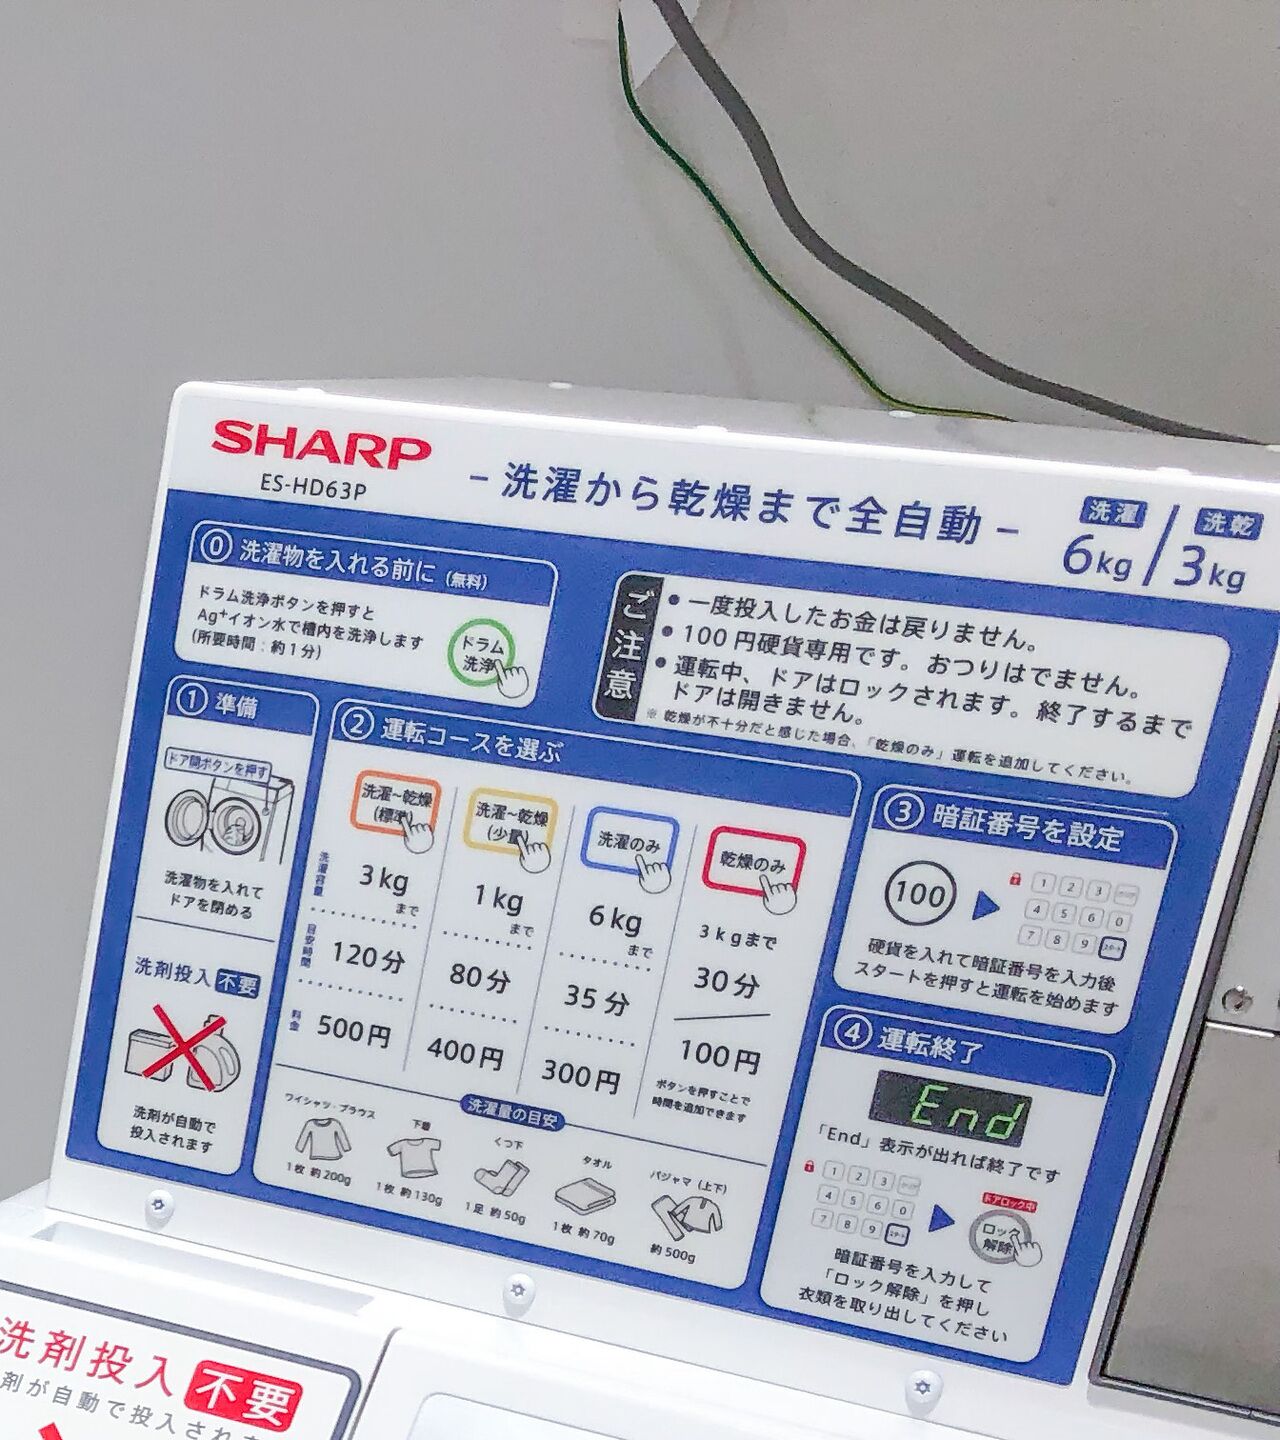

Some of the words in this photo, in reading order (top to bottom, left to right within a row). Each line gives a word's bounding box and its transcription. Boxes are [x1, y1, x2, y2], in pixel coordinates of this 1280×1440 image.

[210, 419, 433, 470] SHARP
[260, 473, 367, 501] ES-HD63P
[239, 538, 436, 584] 洗濯物を入れる前に
[1062, 533, 1133, 582] 6kg
[1173, 544, 1246, 593] 3kg
[198, 585, 375, 622] ドラム洗浄ボタンを押すと
[687, 594, 1039, 653] 一度投入したお金は戻りません。
[461, 635, 505, 656] ドラム
[604, 591, 656, 699] ご注意
[215, 692, 259, 719] 準備
[674, 682, 866, 727] ドアは開きません。
[381, 716, 565, 764] 運転コースを選ぶ
[597, 830, 661, 855] 洗濯のみ
[932, 803, 1125, 853] 暗証番号を設定
[720, 850, 787, 876] 乾燥のみ
[164, 870, 264, 900] 洗濯物を入れて
[359, 864, 409, 896] 3kg
[895, 878, 946, 908] 100
[169, 894, 252, 919] ドアを閉める
[396, 902, 419, 918] まで
[474, 883, 524, 915] 1kg
[509, 921, 535, 938] まで
[589, 904, 643, 936] 6kg
[332, 939, 406, 975] 120分
[627, 944, 654, 960] まで
[867, 937, 1116, 992] 硬貨を入れて暗証番号を入力後
[134, 956, 211, 988] 洗剤投入
[218, 972, 259, 997] 不要
[450, 962, 512, 995] 80分
[694, 967, 760, 999] 30分
[855, 960, 1119, 1017] スタートを押すと運転を始めます
[564, 984, 630, 1018] 35分
[289, 1009, 302, 1032] 料金
[317, 1014, 391, 1050] 500円
[427, 1037, 504, 1073] 400円
[679, 1039, 761, 1076] 100円
[877, 1027, 984, 1066] 運転終了
[541, 1059, 621, 1097] 300円
[656, 1078, 751, 1107] ボタンを押すことで
[133, 1105, 216, 1135] 洗剤が自動で
[412, 1118, 432, 1132] 下着
[467, 1096, 558, 1129] 洗濯量の目安
[651, 1096, 747, 1124] 時間を追加できます
[909, 1083, 1028, 1141] End
[129, 1126, 213, 1154] 投入されます
[494, 1136, 524, 1151] くつ下
[582, 1155, 613, 1170] タオル
[834, 1249, 991, 1293] 暗証番号を入力して
[799, 1287, 1008, 1344] 衣類を取り出してください
[194, 1367, 295, 1426] 不要
